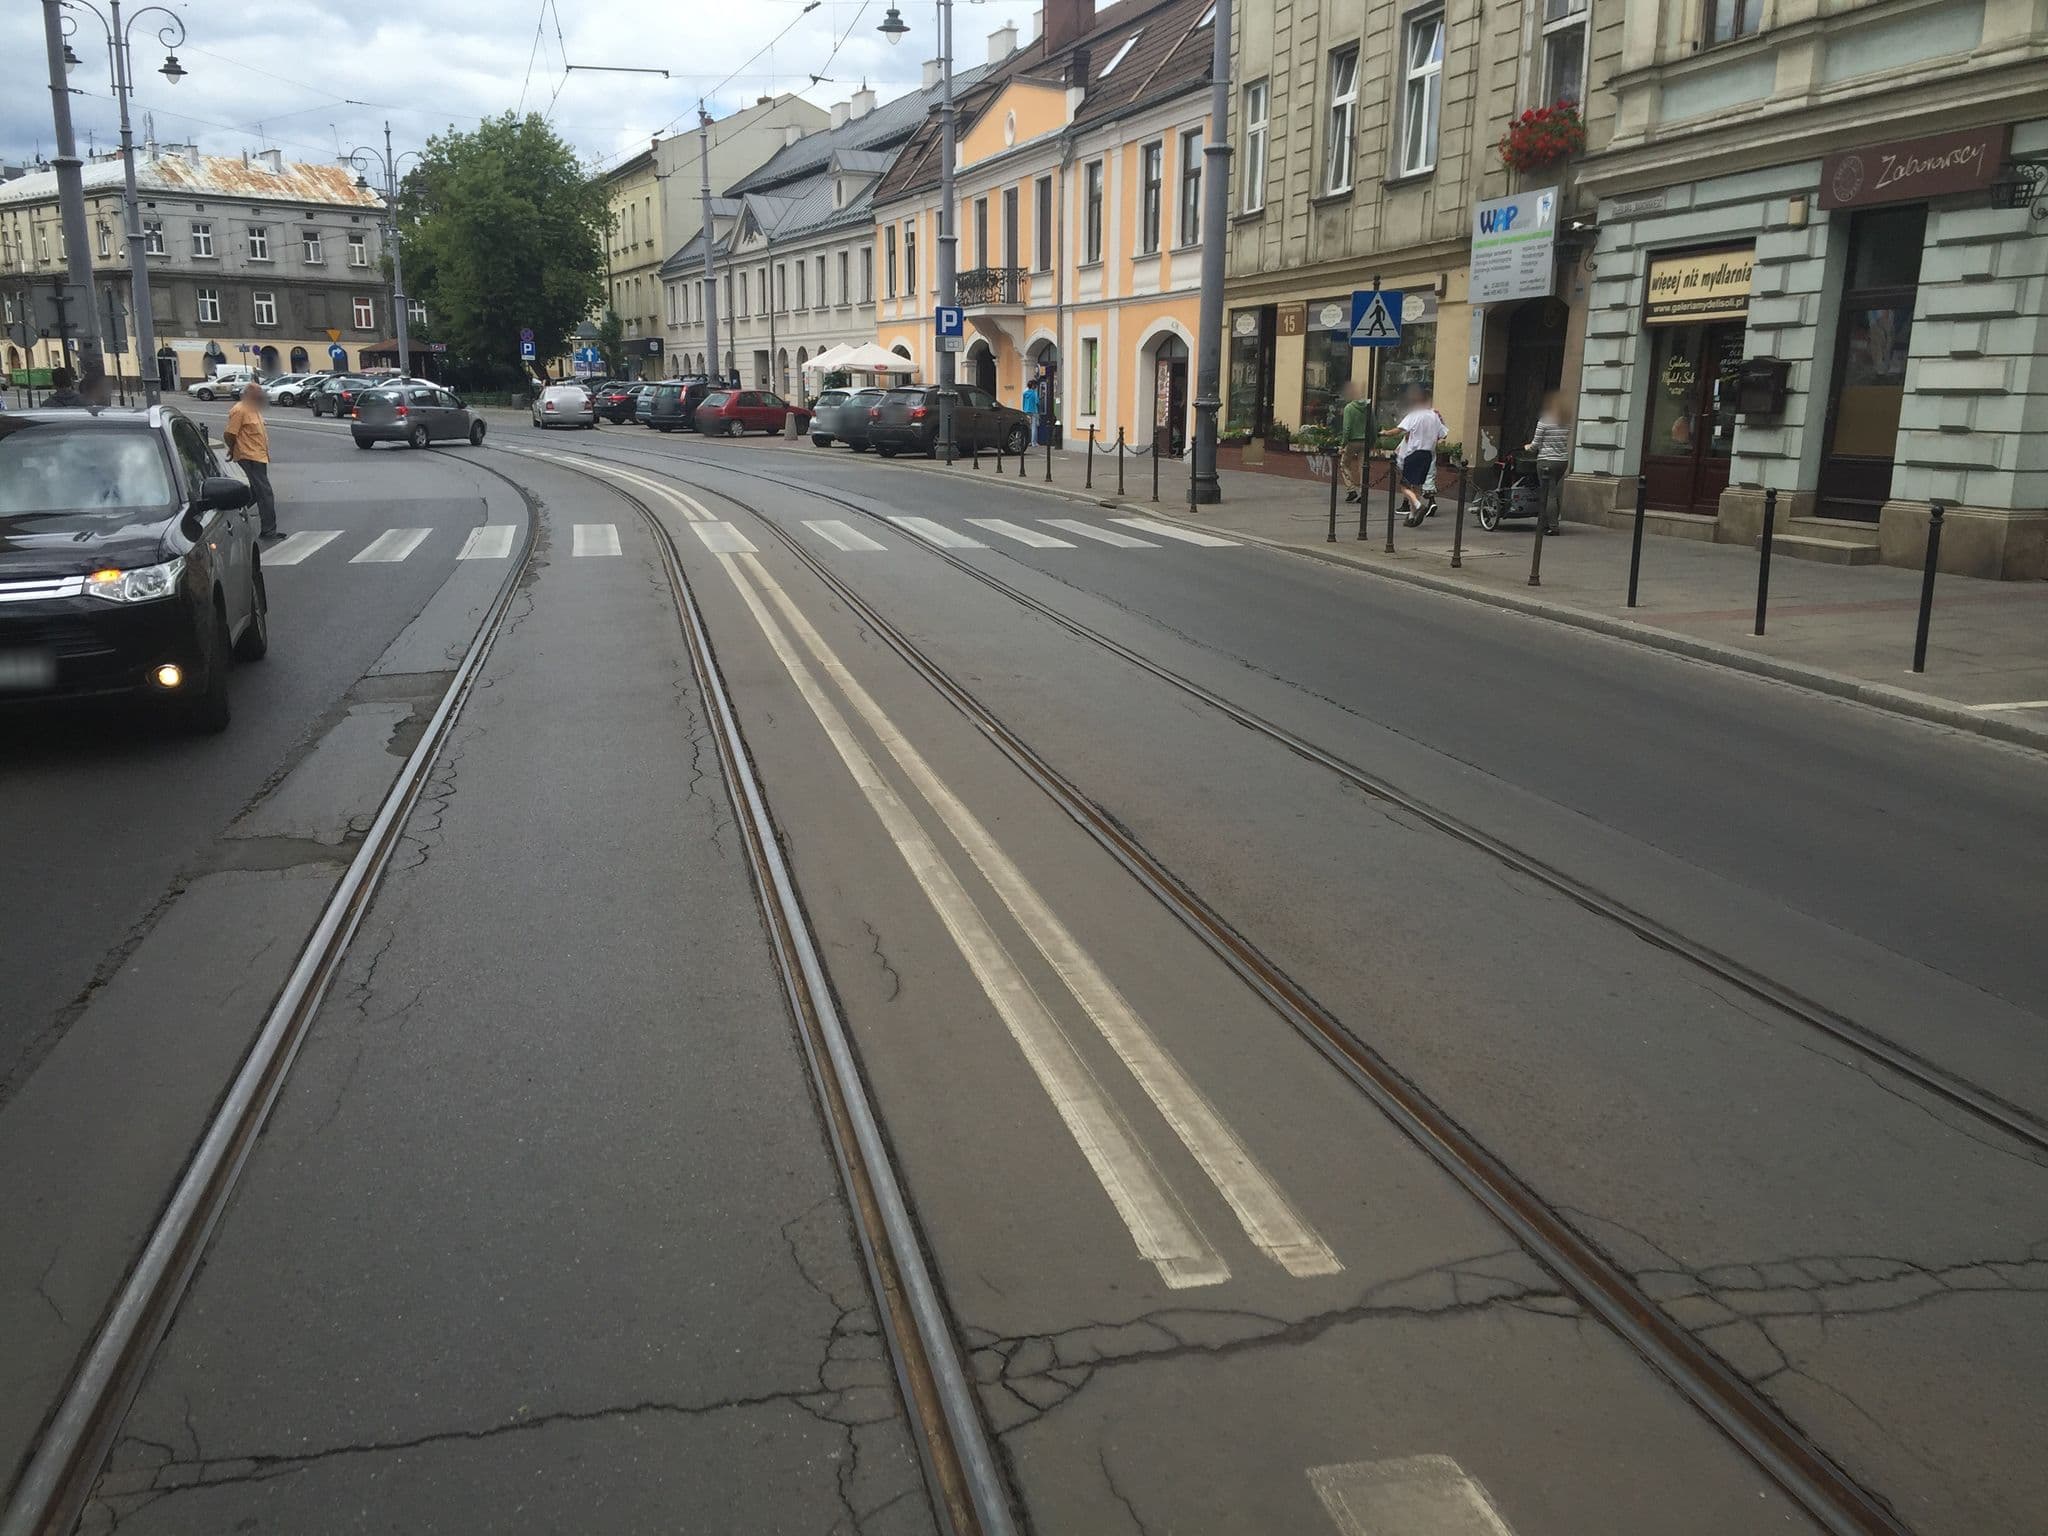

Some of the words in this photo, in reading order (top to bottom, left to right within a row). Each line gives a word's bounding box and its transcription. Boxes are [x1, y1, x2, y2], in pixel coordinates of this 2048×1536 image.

[1480, 205, 1518, 234] WAP
[1651, 269, 1682, 295] więcej
[1683, 268, 1699, 288] niż
[1701, 262, 1753, 292] mydlarnia
[941, 310, 958, 333] P
[1284, 315, 1296, 333] 15
[523, 343, 532, 354] P
